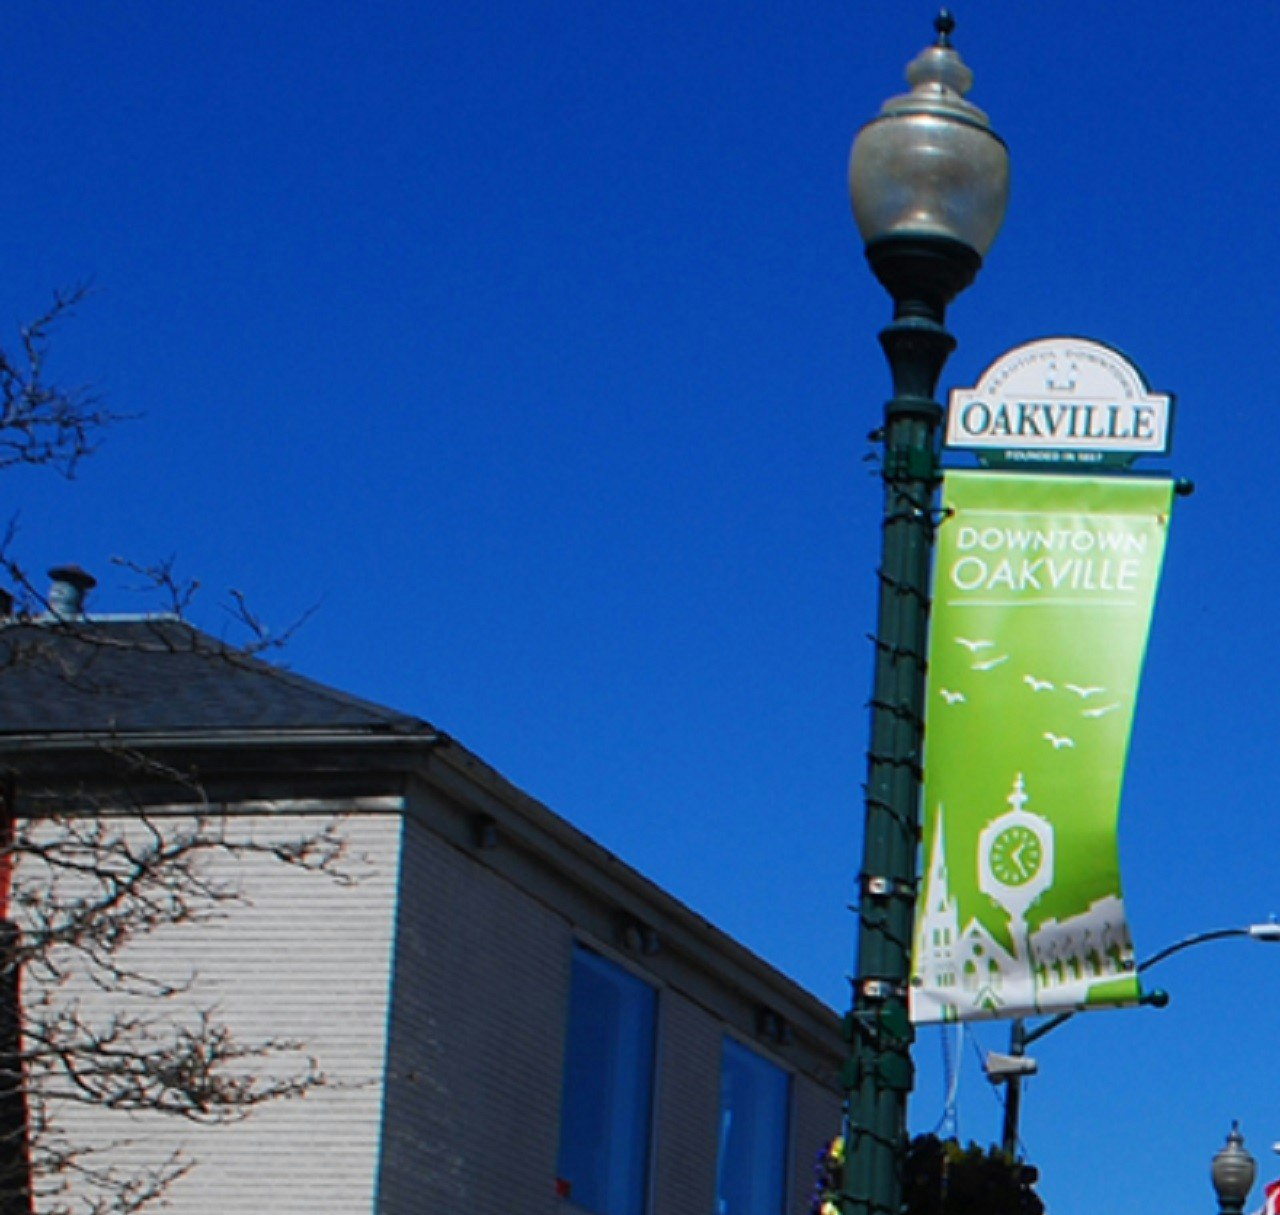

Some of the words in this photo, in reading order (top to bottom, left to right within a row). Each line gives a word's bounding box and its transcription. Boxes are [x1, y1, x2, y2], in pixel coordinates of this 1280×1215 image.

[961, 402, 1155, 439] OAKVILLE
[957, 527, 1148, 552] DOWNTOWN
[950, 556, 1141, 591] OAKVILLE
